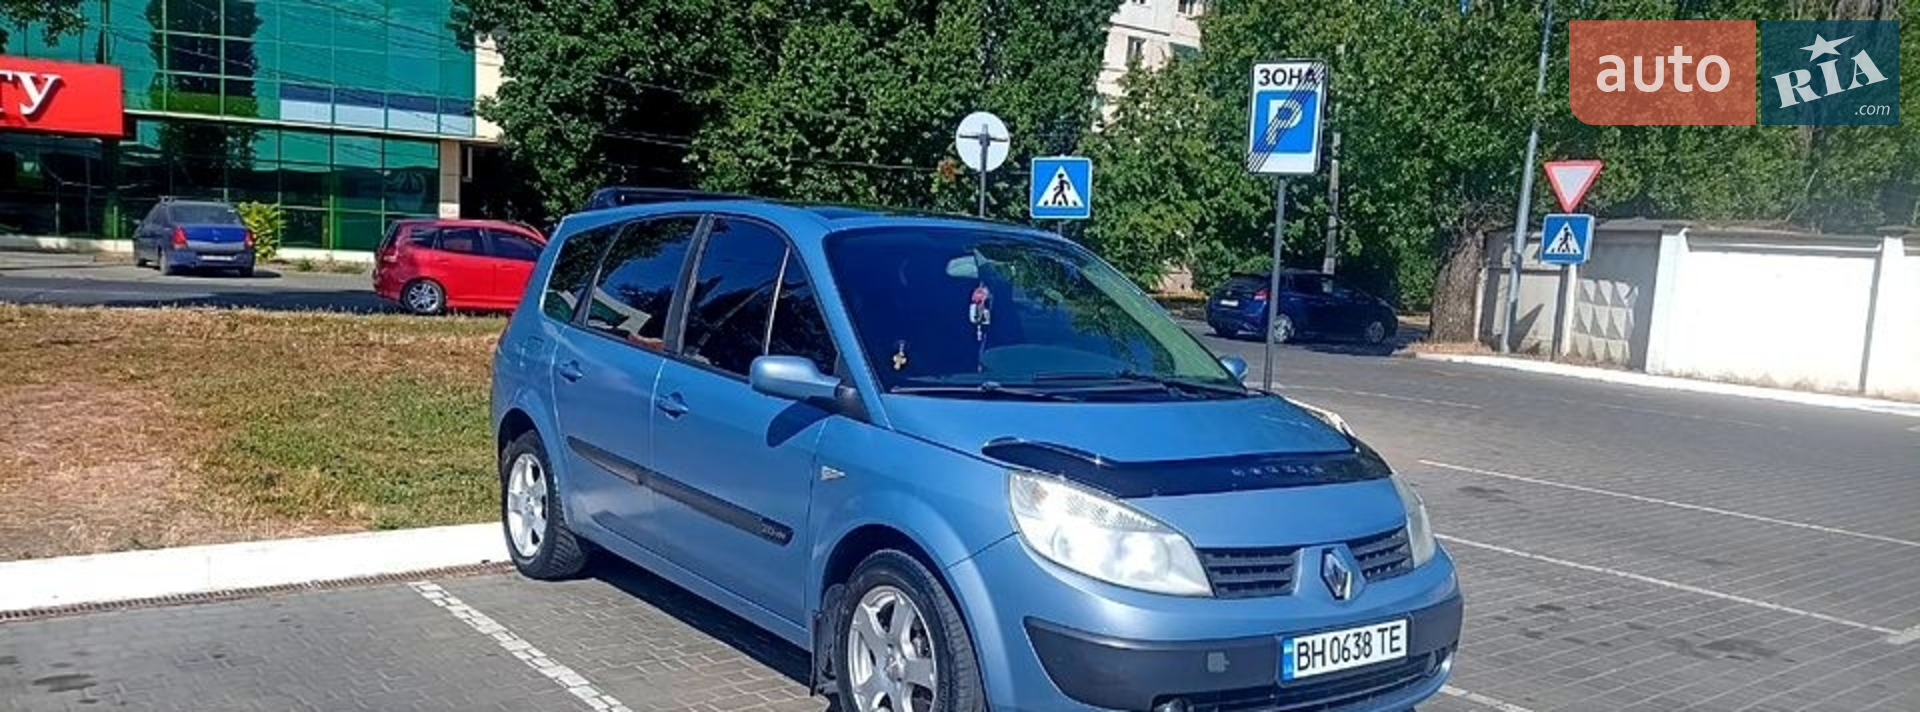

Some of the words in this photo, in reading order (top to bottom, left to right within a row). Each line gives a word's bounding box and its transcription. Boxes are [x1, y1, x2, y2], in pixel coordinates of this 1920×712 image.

[1258, 67, 1317, 87] ЗОНА
[1266, 99, 1303, 145] P
[1377, 625, 1402, 656] TE
